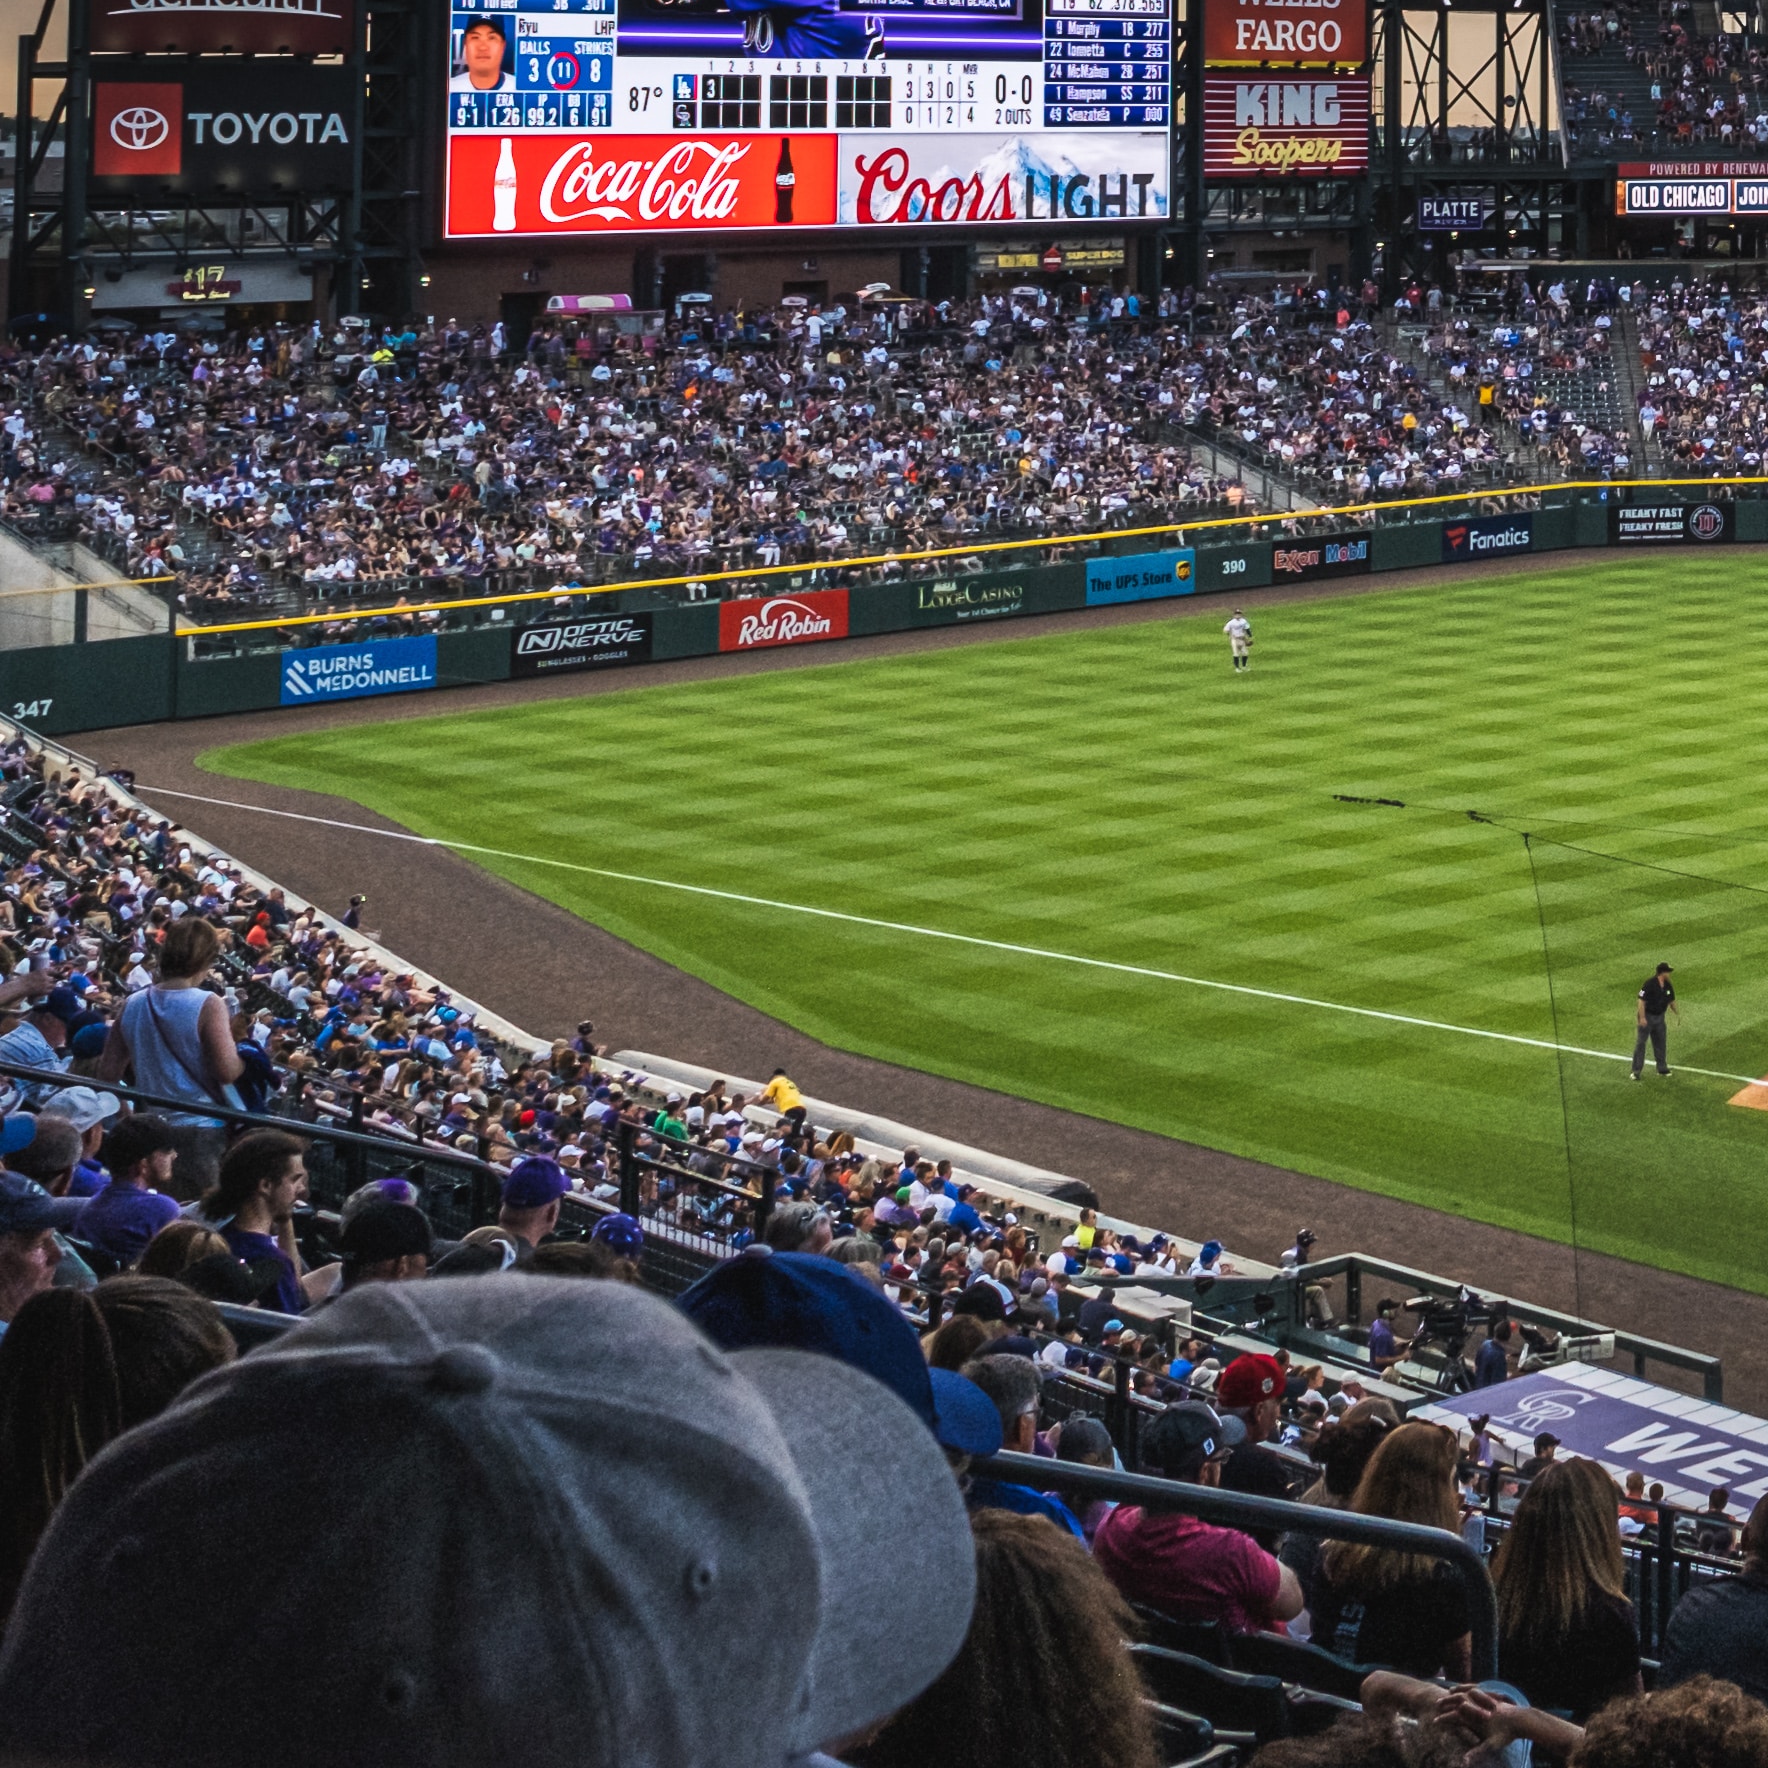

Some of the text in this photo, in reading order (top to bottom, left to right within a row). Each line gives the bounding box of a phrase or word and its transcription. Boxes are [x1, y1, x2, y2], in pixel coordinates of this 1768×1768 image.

[1235, 19, 1341, 52] FARGO
[519, 41, 613, 55] BALLS STRIKES
[528, 58, 600, 82] 3 11 8
[629, 86, 663, 112] 87°
[1235, 85, 1341, 126] KING
[491, 108, 557, 127] 1.26 99.2
[995, 108, 1032, 125] 2 OUTS
[188, 113, 348, 144] TOYOTA
[1232, 127, 1342, 174] Soopers
[1650, 163, 1700, 176] POWERED
[1705, 163, 1717, 175] BY
[539, 140, 752, 222] Coca-Cola
[856, 147, 1155, 224] Coors LIGHT
[1632, 185, 1724, 208] OLD CHICAGO
[1423, 201, 1478, 217] PLATTE
[1620, 507, 1683, 518] FREAKY FAST
[1620, 521, 1683, 531] FREAKY FRESH
[1469, 528, 1529, 550] Fanatics
[1222, 559, 1246, 575] 390
[1275, 542, 1367, 572] Exxon Mobil
[1090, 571, 1172, 592] The UPS Store
[563, 620, 634, 637] OPTIC
[738, 611, 830, 645] Red Robin
[557, 630, 647, 650] NERVE
[309, 653, 373, 676] BURNS
[317, 665, 432, 691] McDONNELL
[13, 698, 53, 719] 347
